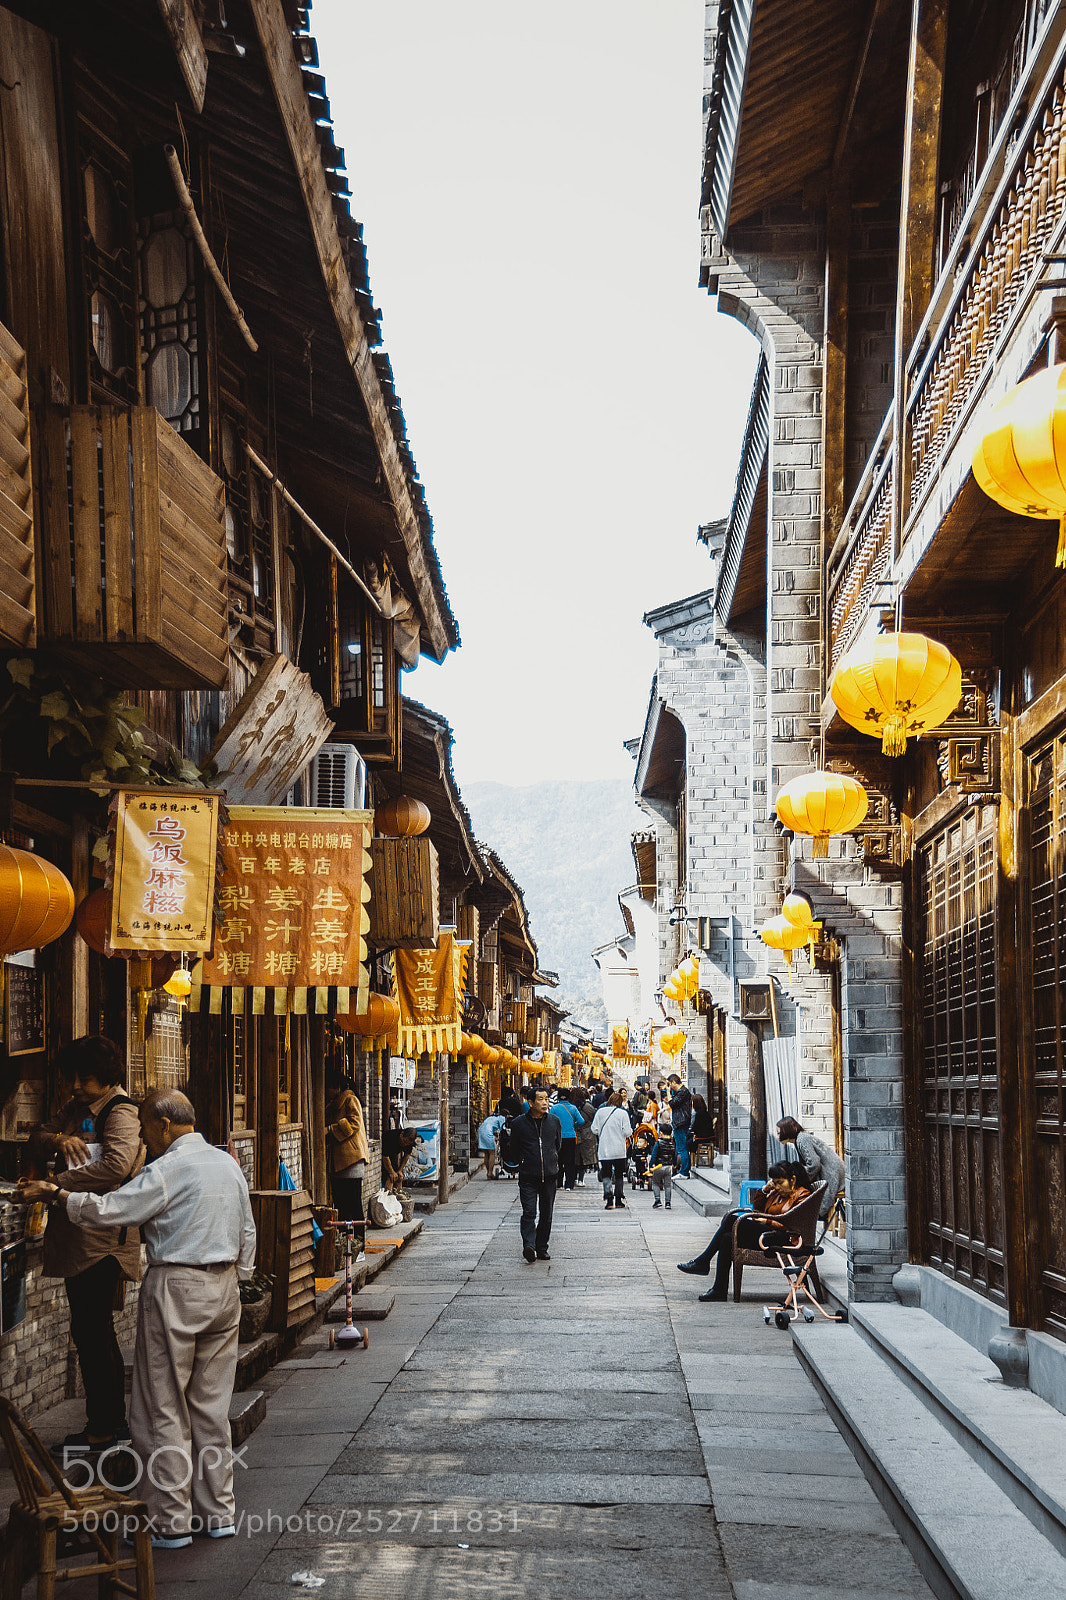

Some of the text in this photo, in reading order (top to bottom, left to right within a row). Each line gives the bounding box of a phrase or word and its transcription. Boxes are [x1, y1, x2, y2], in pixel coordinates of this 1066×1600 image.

[143, 816, 188, 915] 乌饭麻糍
[238, 856, 332, 876] 百年老店
[217, 885, 256, 976] 梨膏糖
[263, 885, 303, 976] 姜汁糖
[310, 885, 350, 976] 生姜糖
